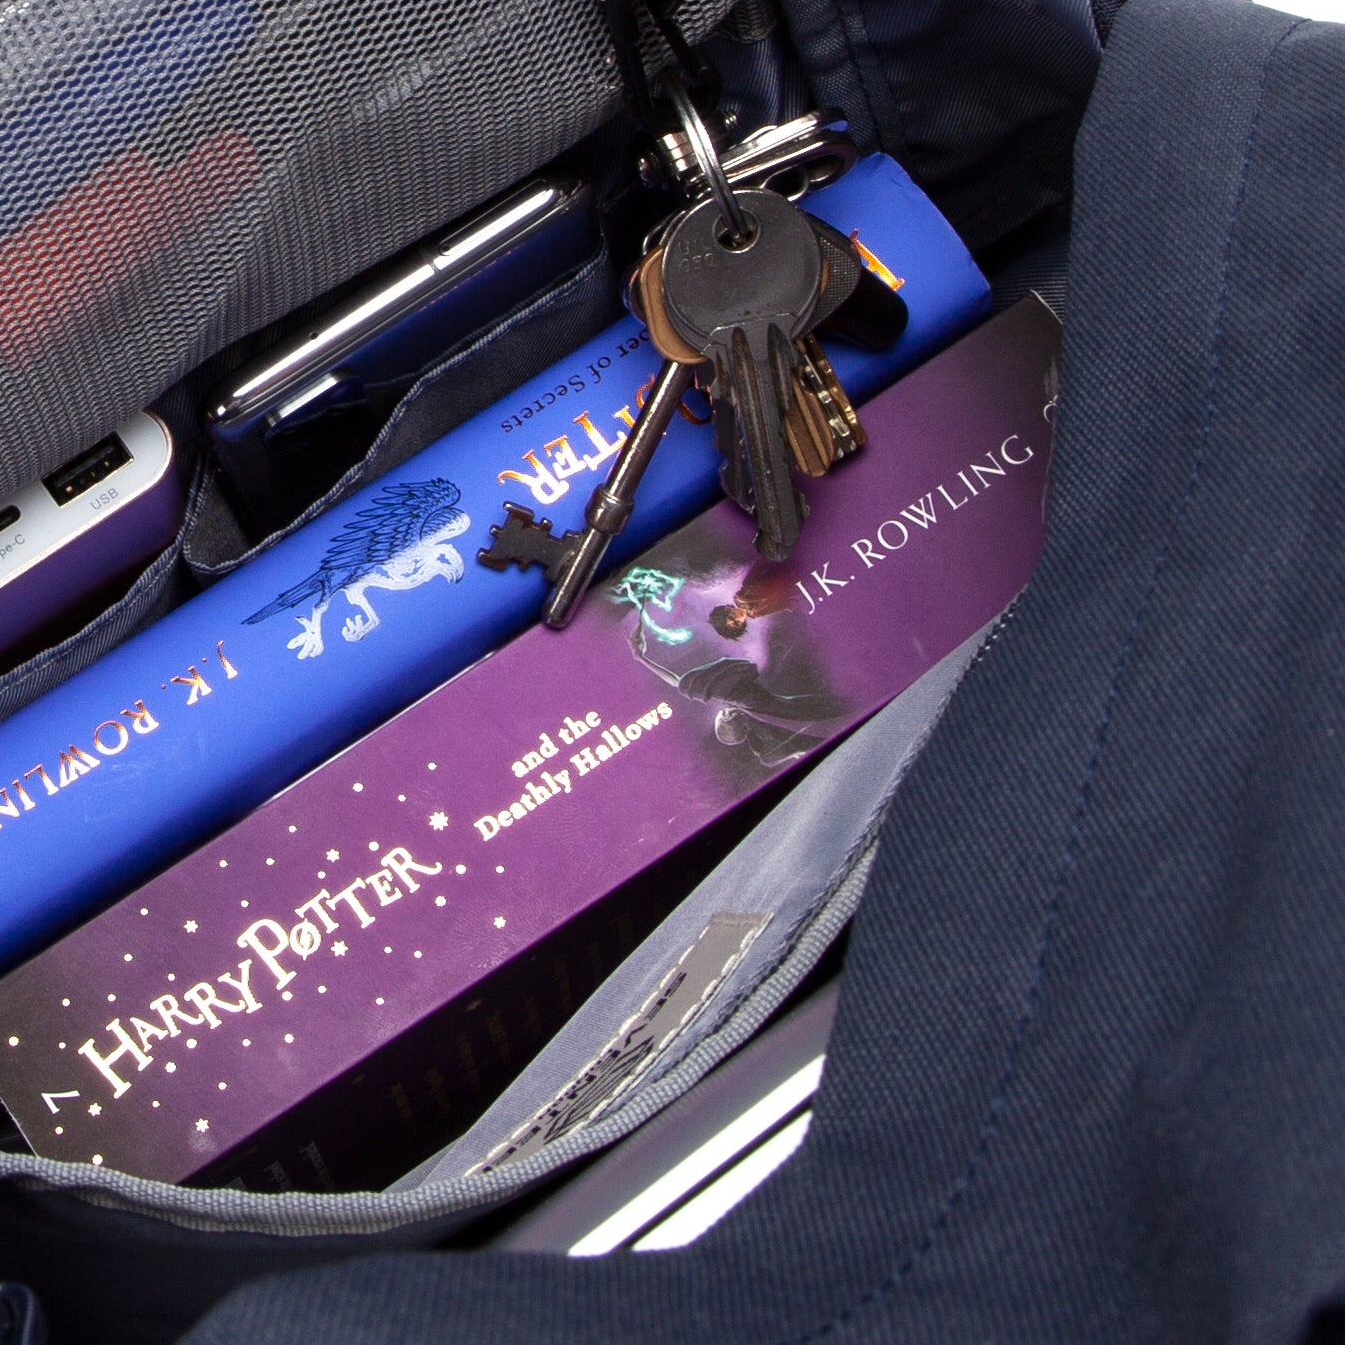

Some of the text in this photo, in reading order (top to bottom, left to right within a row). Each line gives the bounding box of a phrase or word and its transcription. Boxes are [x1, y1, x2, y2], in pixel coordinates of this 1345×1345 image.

[500, 355, 612, 433] of Secrets
[90, 488, 119, 511] USB
[795, 434, 1035, 615] J.K. ROWLING
[473, 702, 673, 842] Deathly Hallows
[511, 711, 602, 778] and the
[77, 959, 263, 1099] HARRY
[236, 847, 443, 990] POTTER
